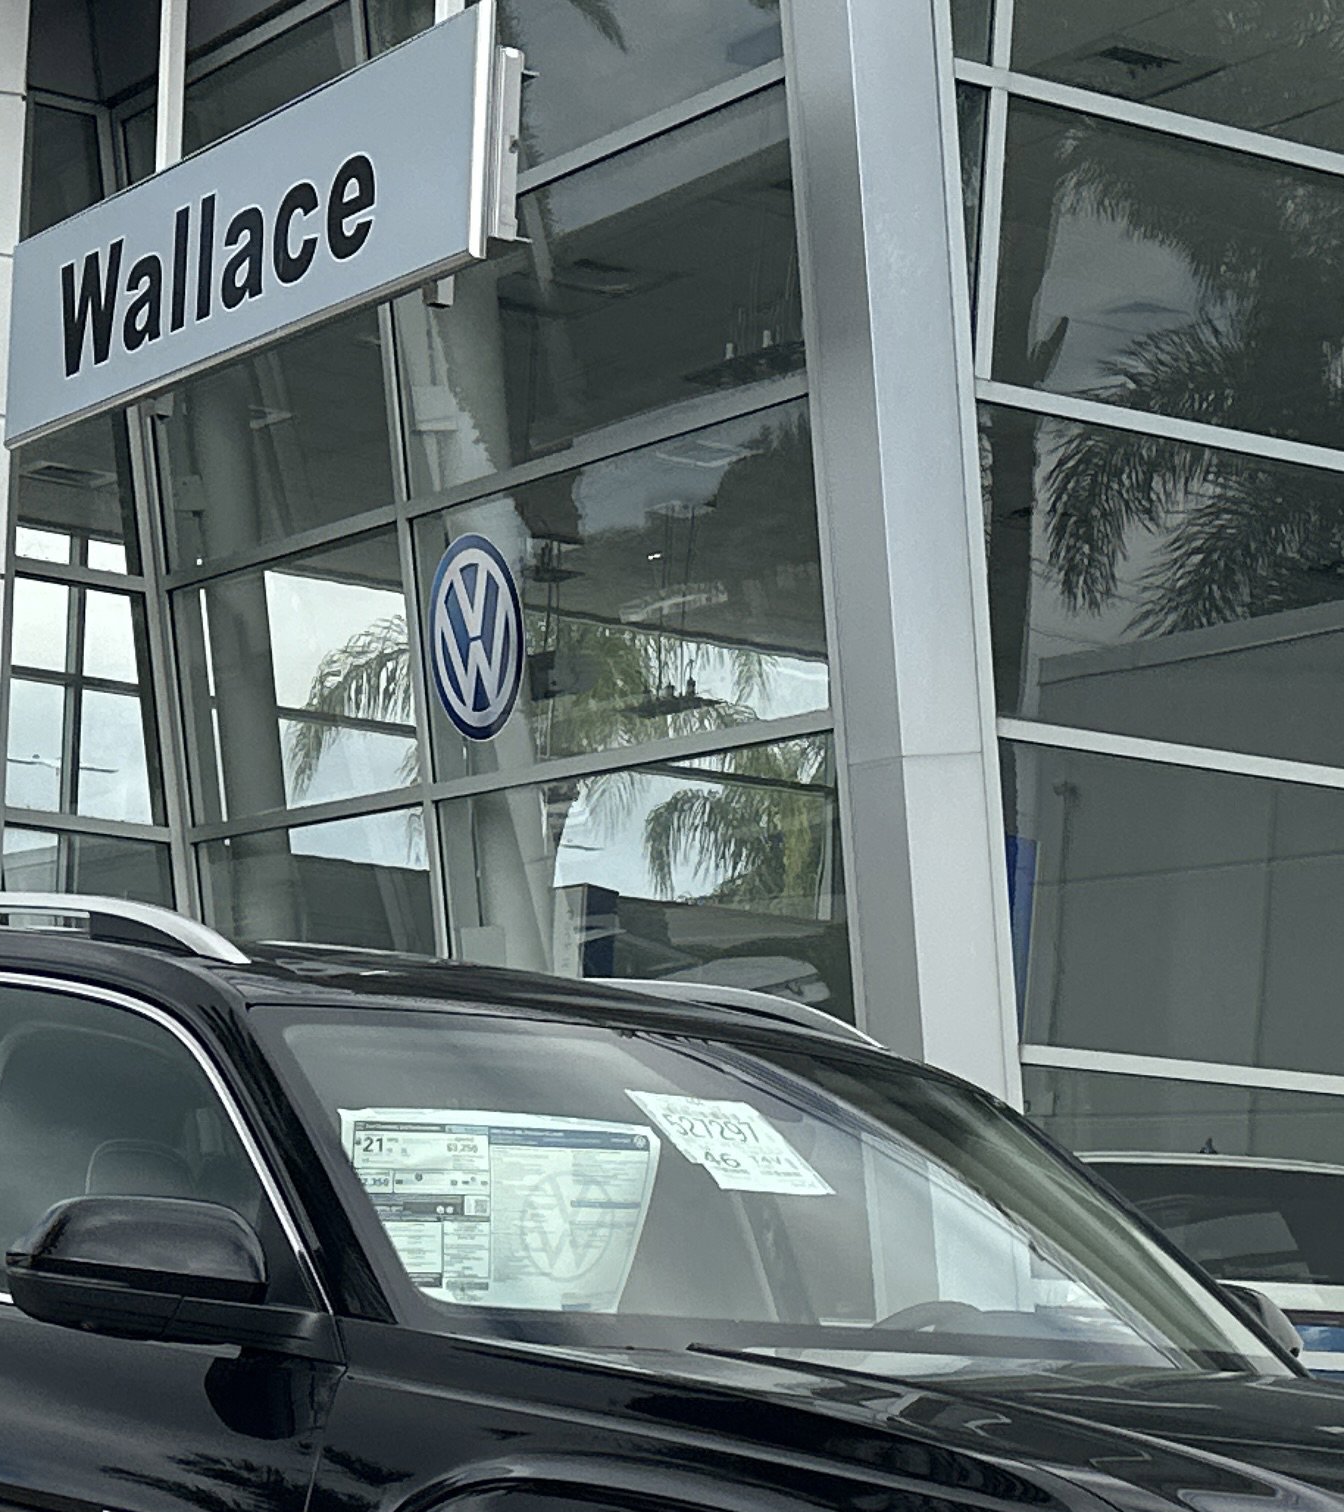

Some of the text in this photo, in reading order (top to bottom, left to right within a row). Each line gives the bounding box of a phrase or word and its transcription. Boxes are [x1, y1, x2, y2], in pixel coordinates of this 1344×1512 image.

[61, 154, 376, 378] Wallace
[435, 548, 520, 727] VW
[363, 1137, 383, 1152] 21
[662, 1112, 759, 1142] 527297
